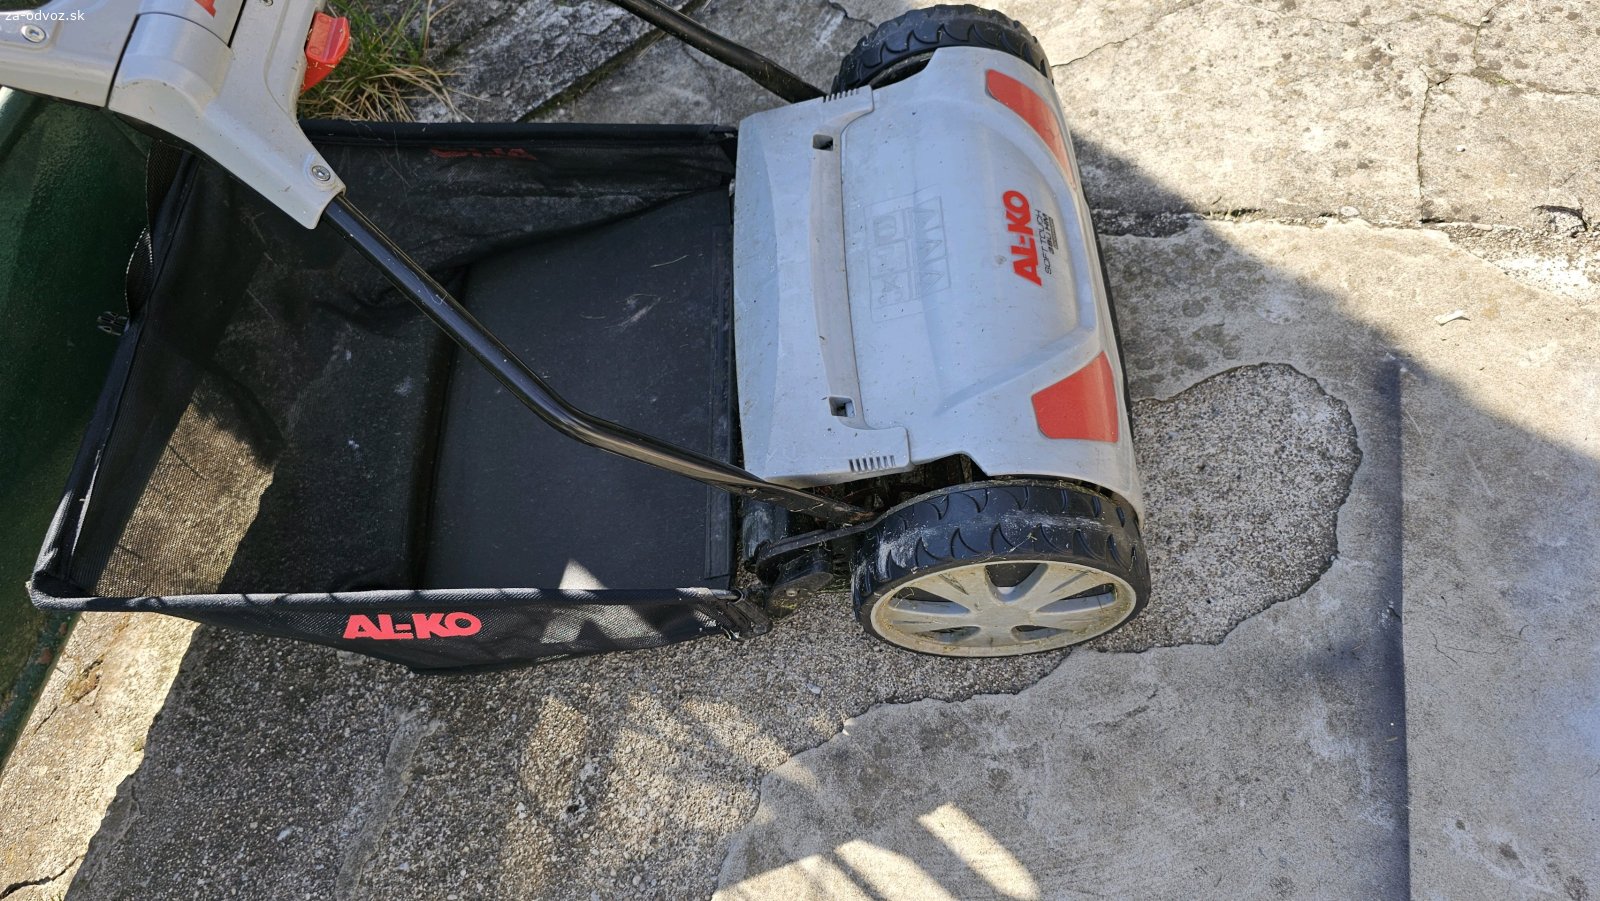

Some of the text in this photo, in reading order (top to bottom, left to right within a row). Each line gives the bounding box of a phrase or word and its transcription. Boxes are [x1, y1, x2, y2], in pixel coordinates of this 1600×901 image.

[1002, 189, 1042, 287] AL-KO
[1035, 208, 1052, 275] SOFT TOUCH
[342, 611, 482, 640] AL-KO
